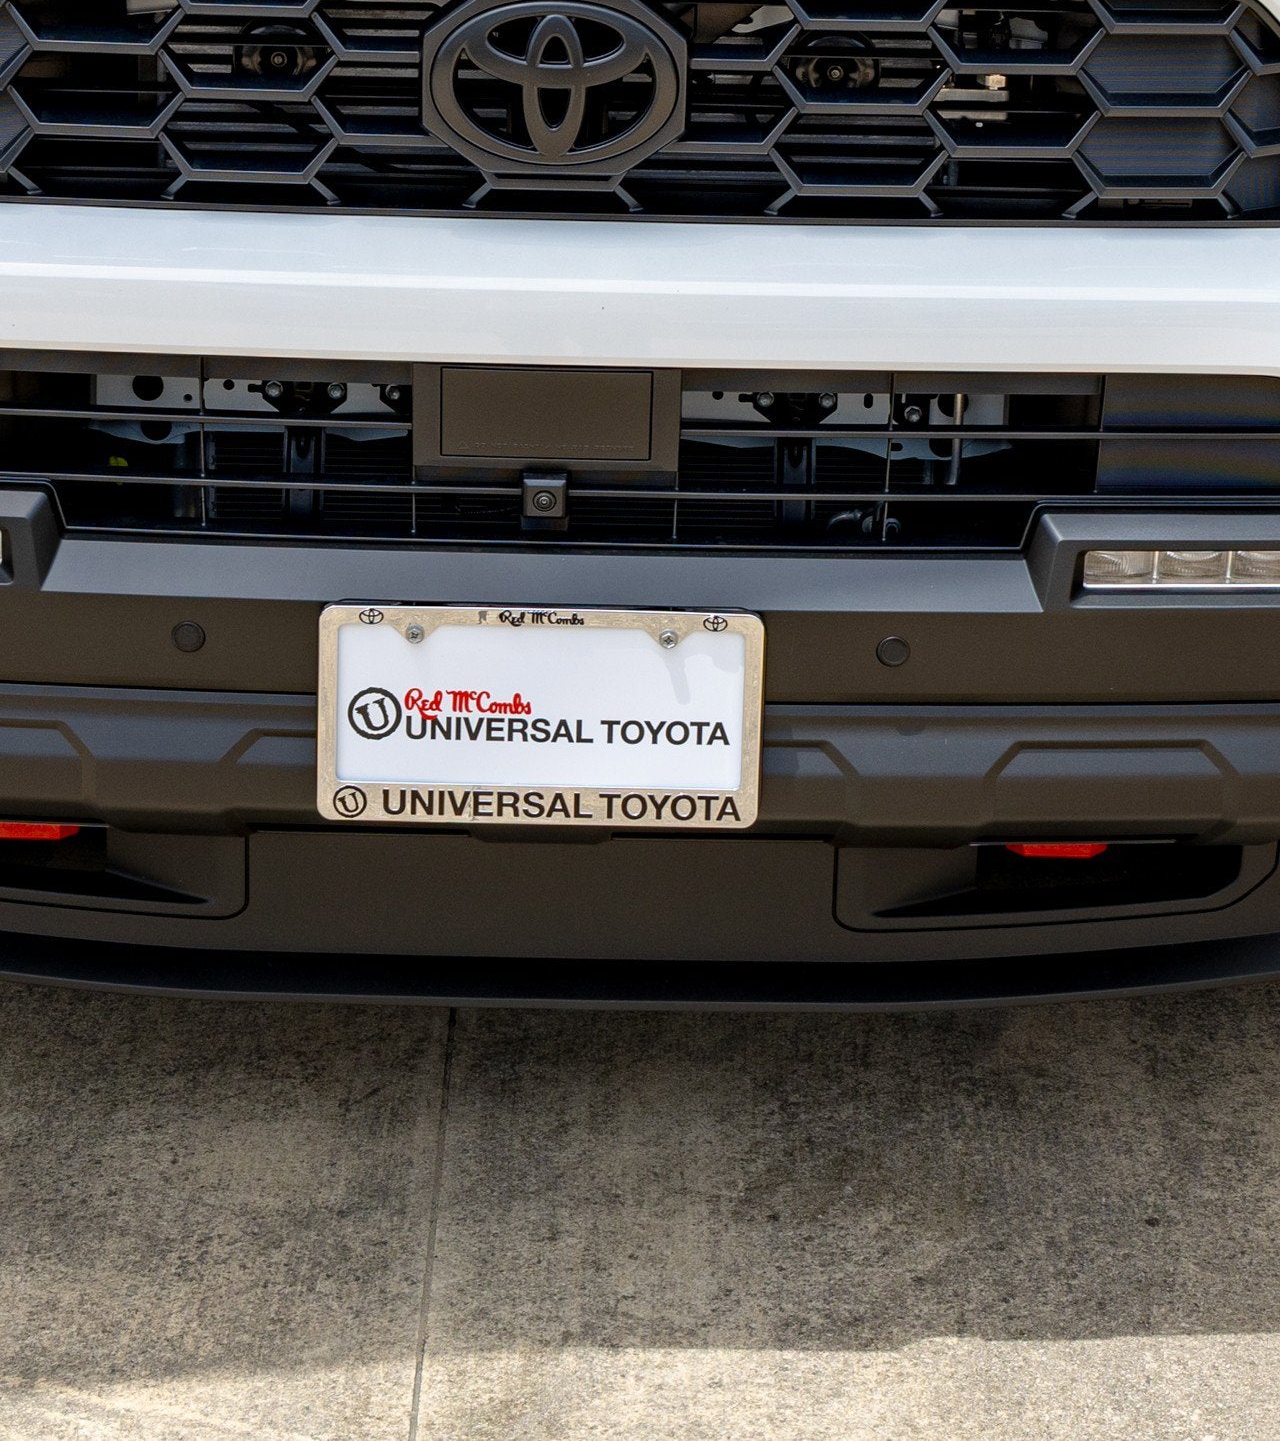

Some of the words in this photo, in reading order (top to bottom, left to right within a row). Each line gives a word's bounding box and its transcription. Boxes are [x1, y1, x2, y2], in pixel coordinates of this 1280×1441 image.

[498, 609, 526, 627] Red
[404, 688, 443, 720] Red
[446, 690, 532, 716] McCombs
[406, 715, 594, 743] UNIVERSAL
[601, 720, 730, 745] TOYOTA
[382, 788, 593, 819] UNIVERSAL
[599, 793, 741, 821] TOYOTA
